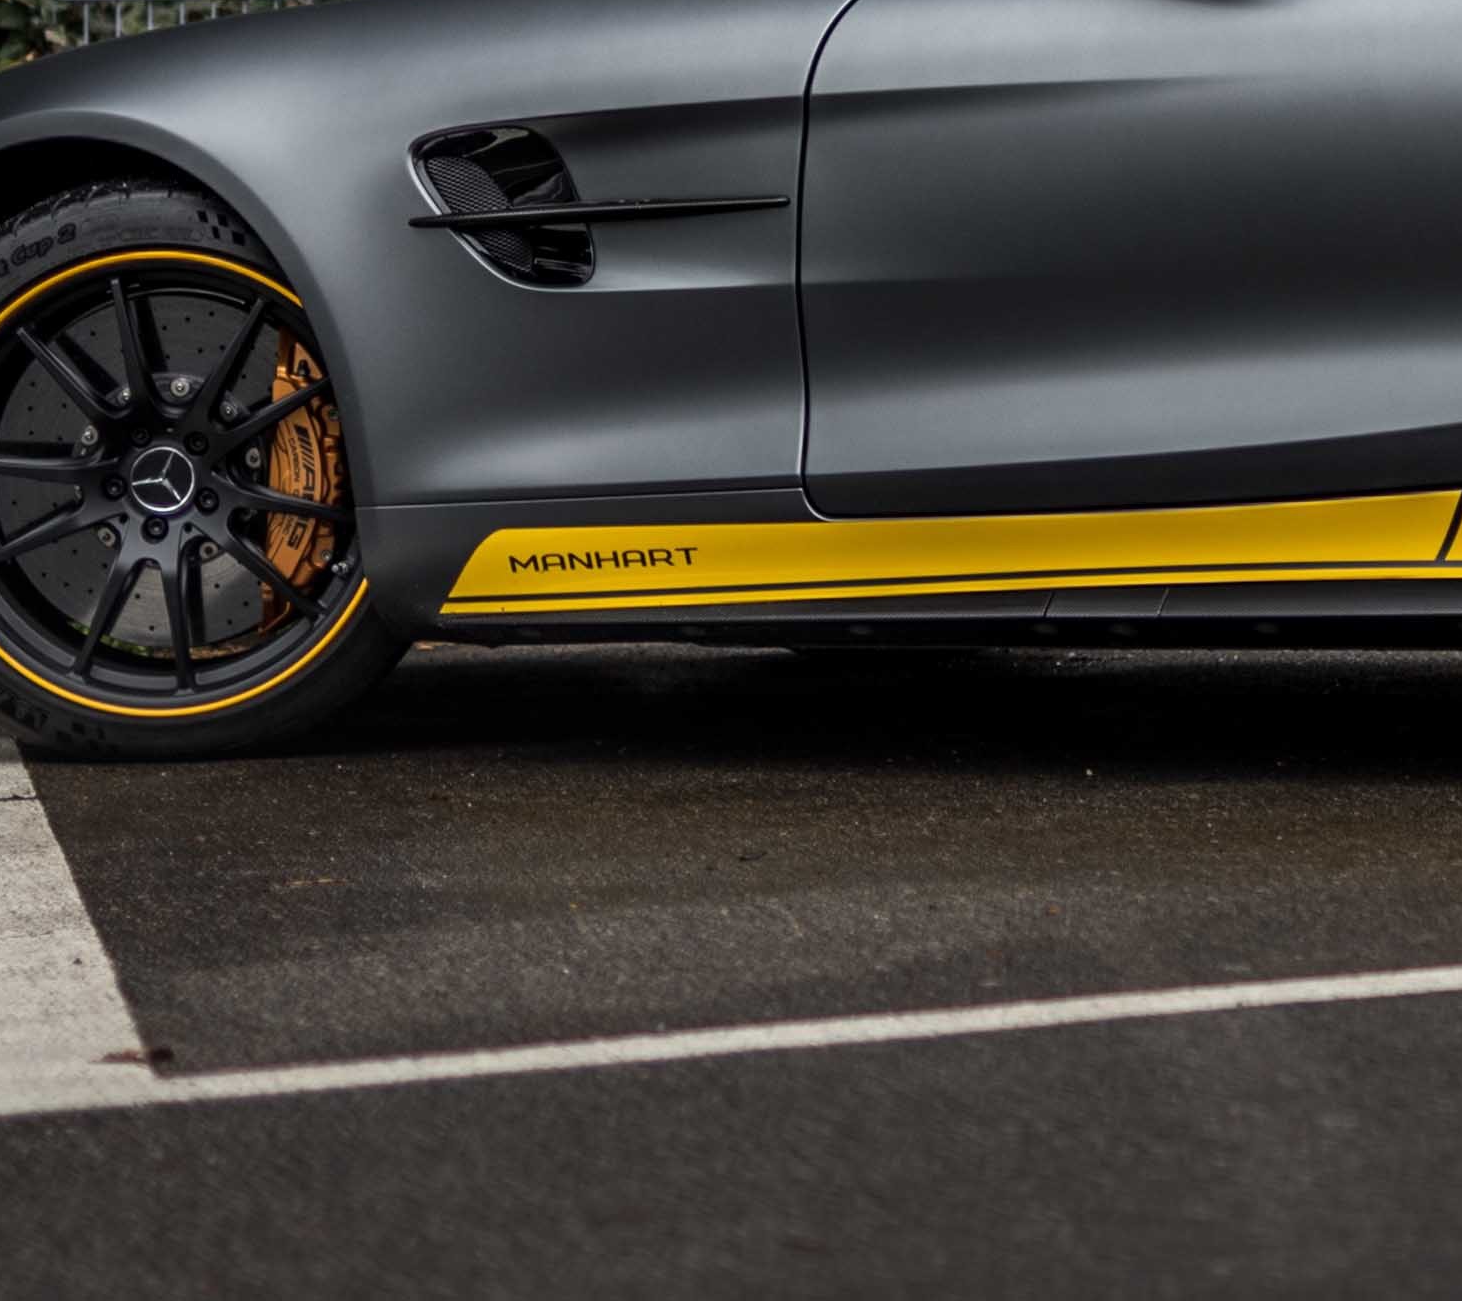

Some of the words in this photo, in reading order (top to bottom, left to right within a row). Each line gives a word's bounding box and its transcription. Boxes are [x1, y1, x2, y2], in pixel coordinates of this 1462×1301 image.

[11, 236, 54, 266] Cup
[57, 223, 76, 245] 2
[508, 547, 698, 574] MANHART
